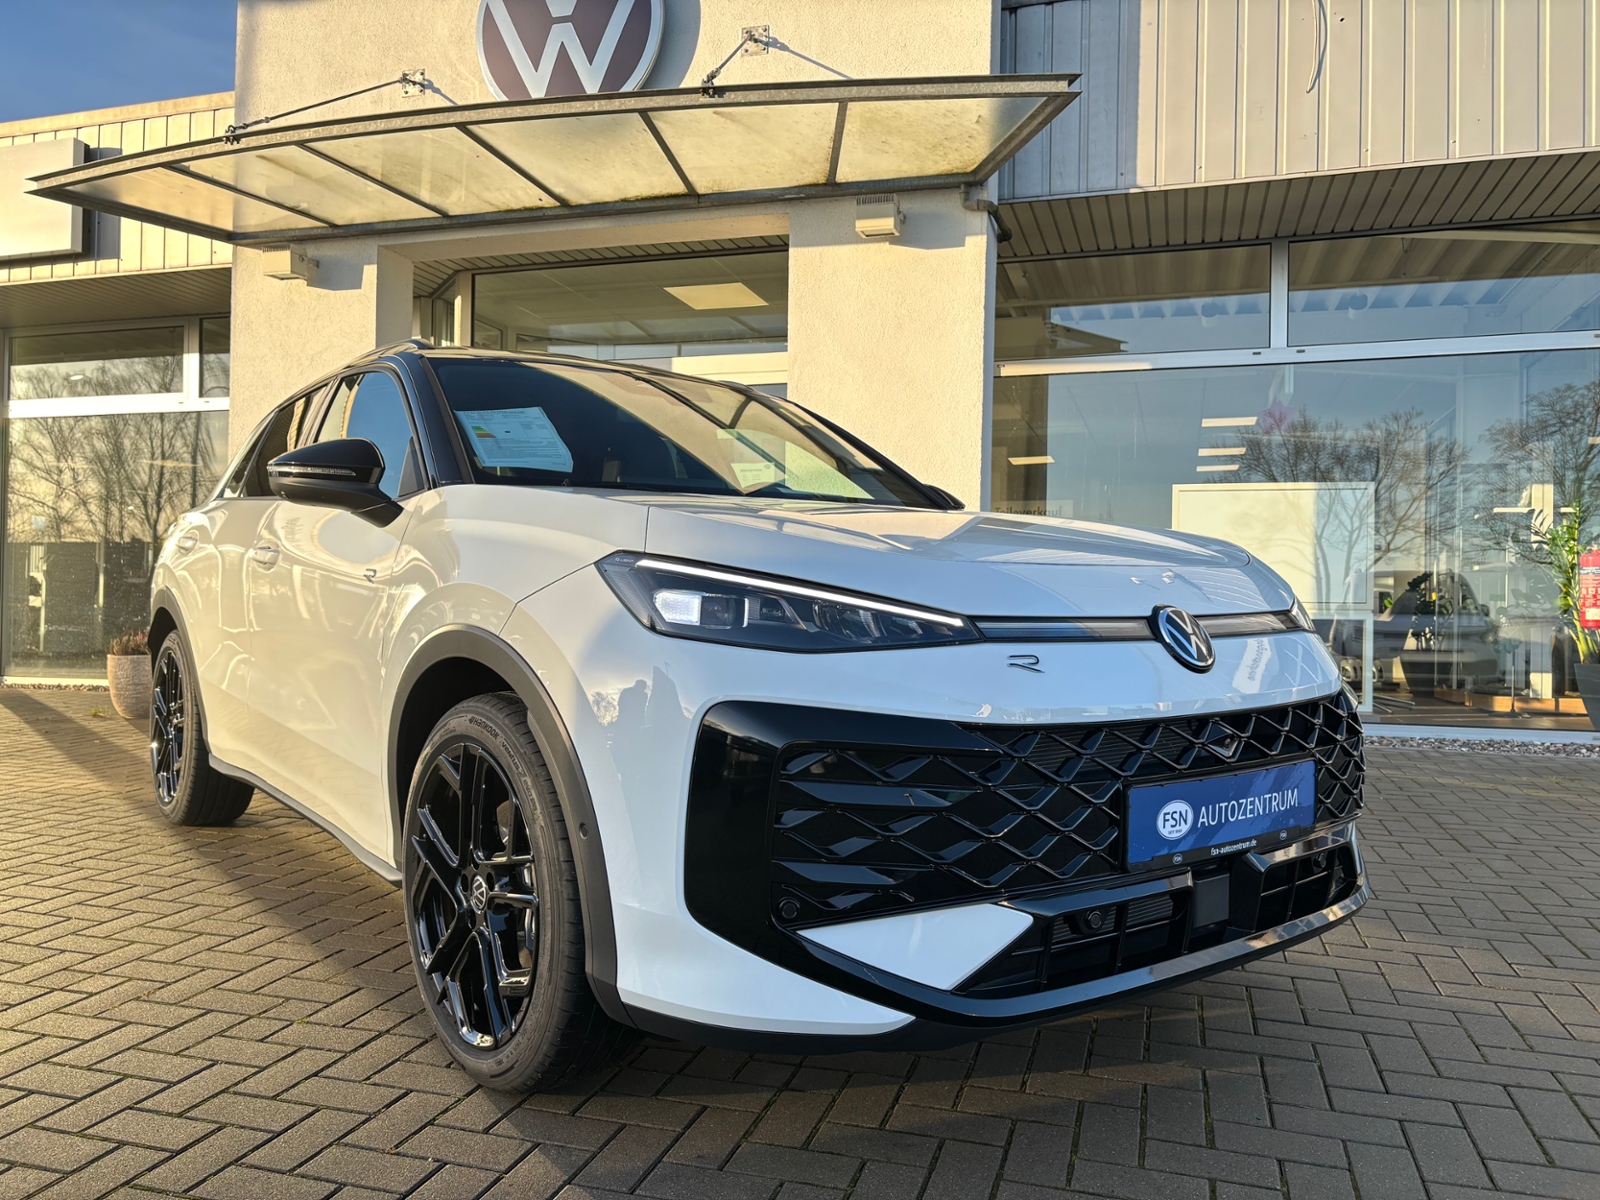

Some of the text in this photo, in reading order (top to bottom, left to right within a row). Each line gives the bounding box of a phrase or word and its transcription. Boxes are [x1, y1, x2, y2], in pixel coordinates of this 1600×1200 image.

[1007, 654, 1046, 674] R
[1162, 808, 1188, 829] FSN
[1197, 788, 1299, 828] AUTOZENTRUM
